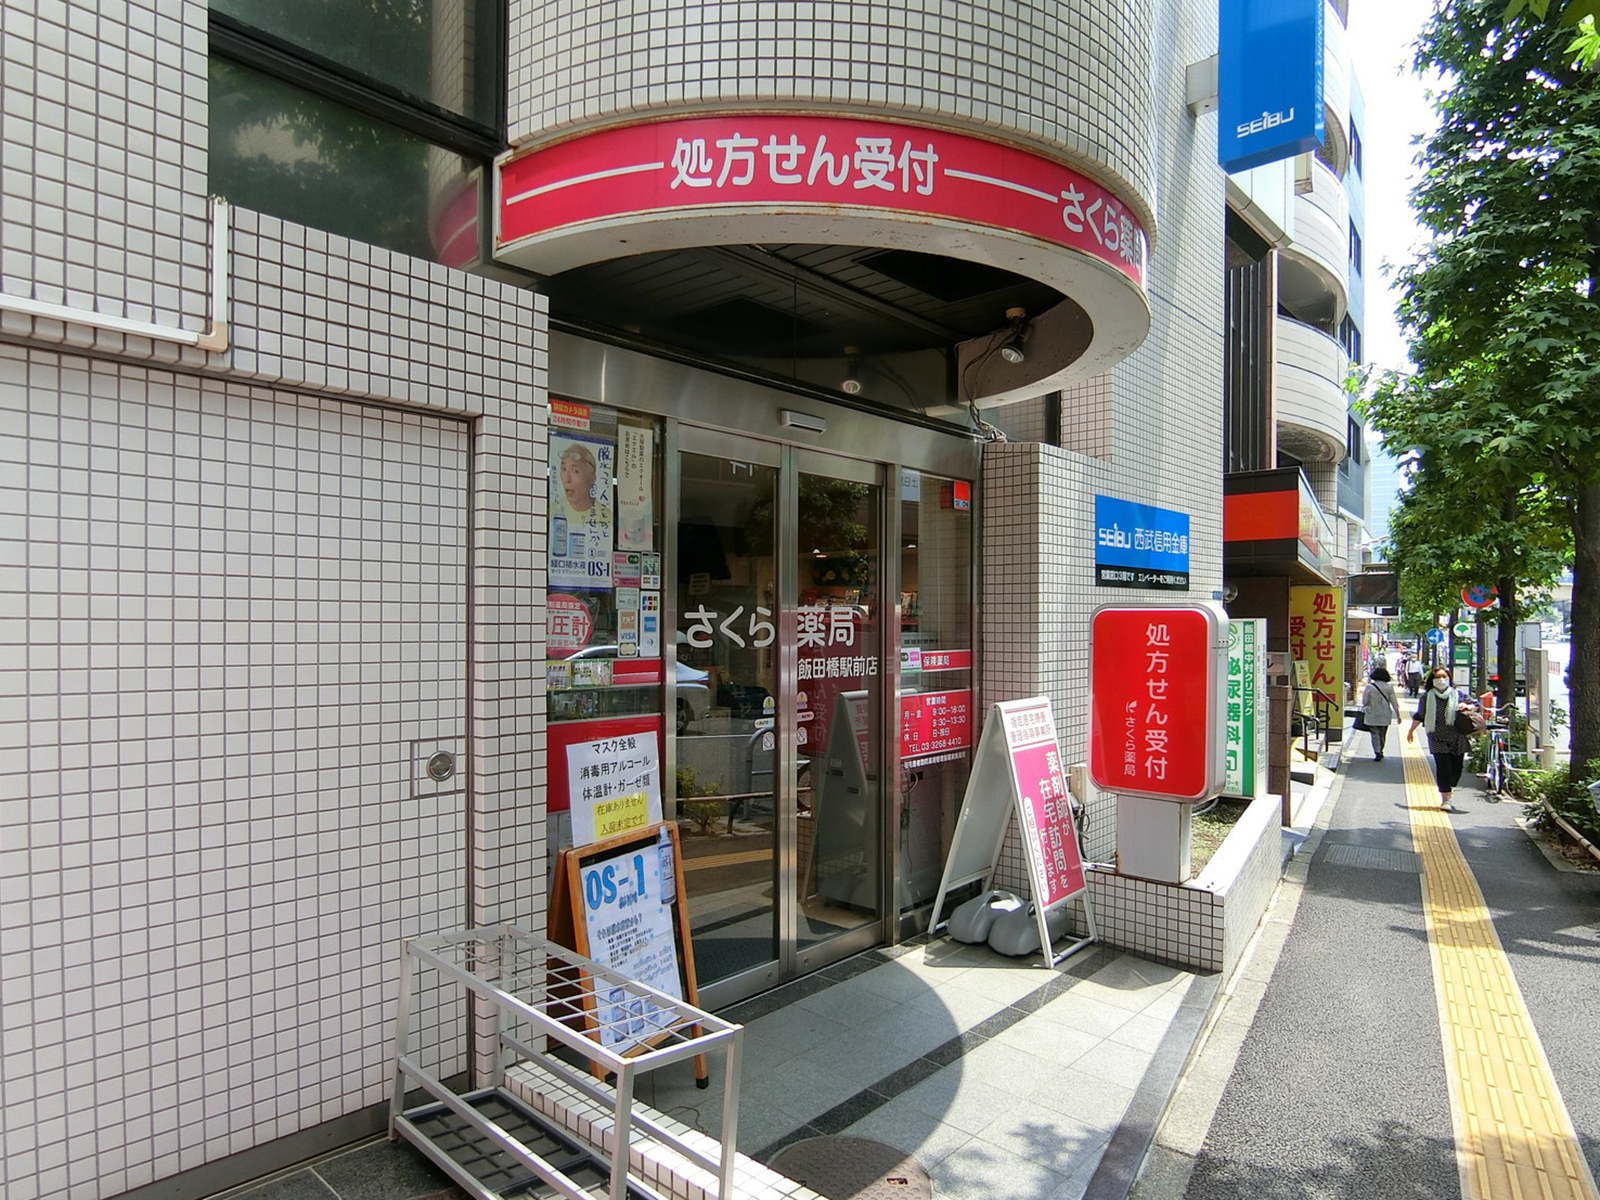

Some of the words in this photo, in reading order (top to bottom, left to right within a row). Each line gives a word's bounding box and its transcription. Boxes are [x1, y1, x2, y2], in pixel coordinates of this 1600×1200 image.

[670, 133, 939, 197] 処方せん受付
[1134, 527, 1188, 556] 西武信用金庫
[620, 632, 636, 640] VISA
[1311, 592, 1337, 686] 処方せん
[796, 655, 878, 680] 飯田橋駅前店
[1144, 623, 1171, 781] 処方せん受付
[592, 737, 637, 754] マスク全般
[1123, 716, 1137, 777] さくら薬局
[580, 756, 651, 780] 消毒用アルコール
[582, 773, 651, 801] 体温計・ガーゼ類
[596, 795, 645, 816] 在庫ありません
[1045, 750, 1070, 837] 薬剤師が
[1038, 778, 1069, 890] 在宅訪問を
[586, 854, 646, 910] OS-1
